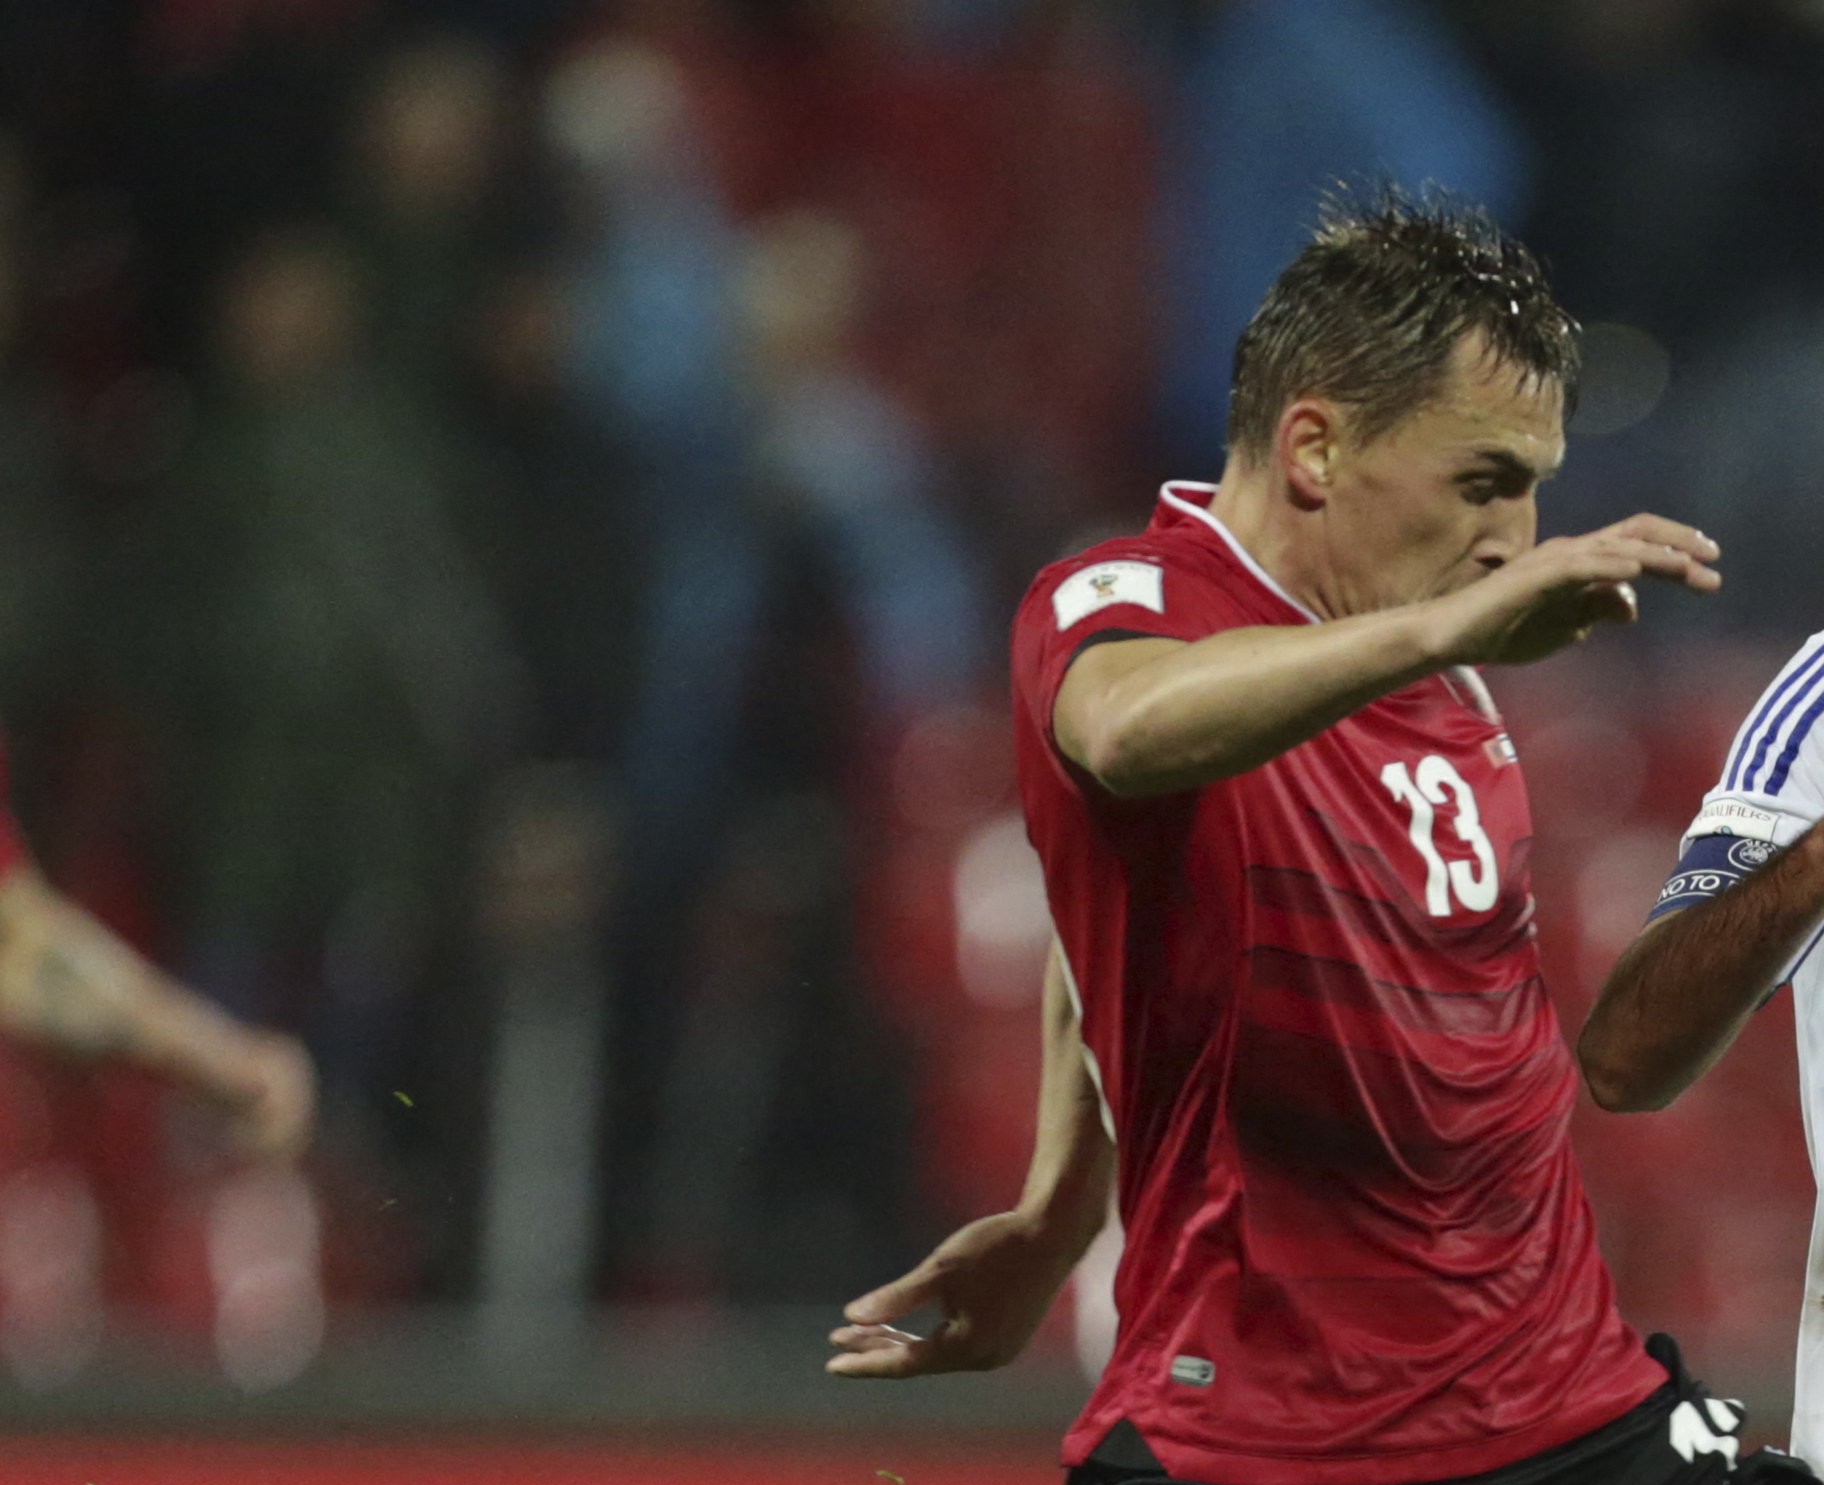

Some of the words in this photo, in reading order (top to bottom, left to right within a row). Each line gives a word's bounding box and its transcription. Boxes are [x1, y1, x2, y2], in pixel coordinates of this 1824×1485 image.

[1380, 755, 1498, 917] 13
[1656, 878, 1686, 903] NO
[1689, 875, 1721, 891] TO
